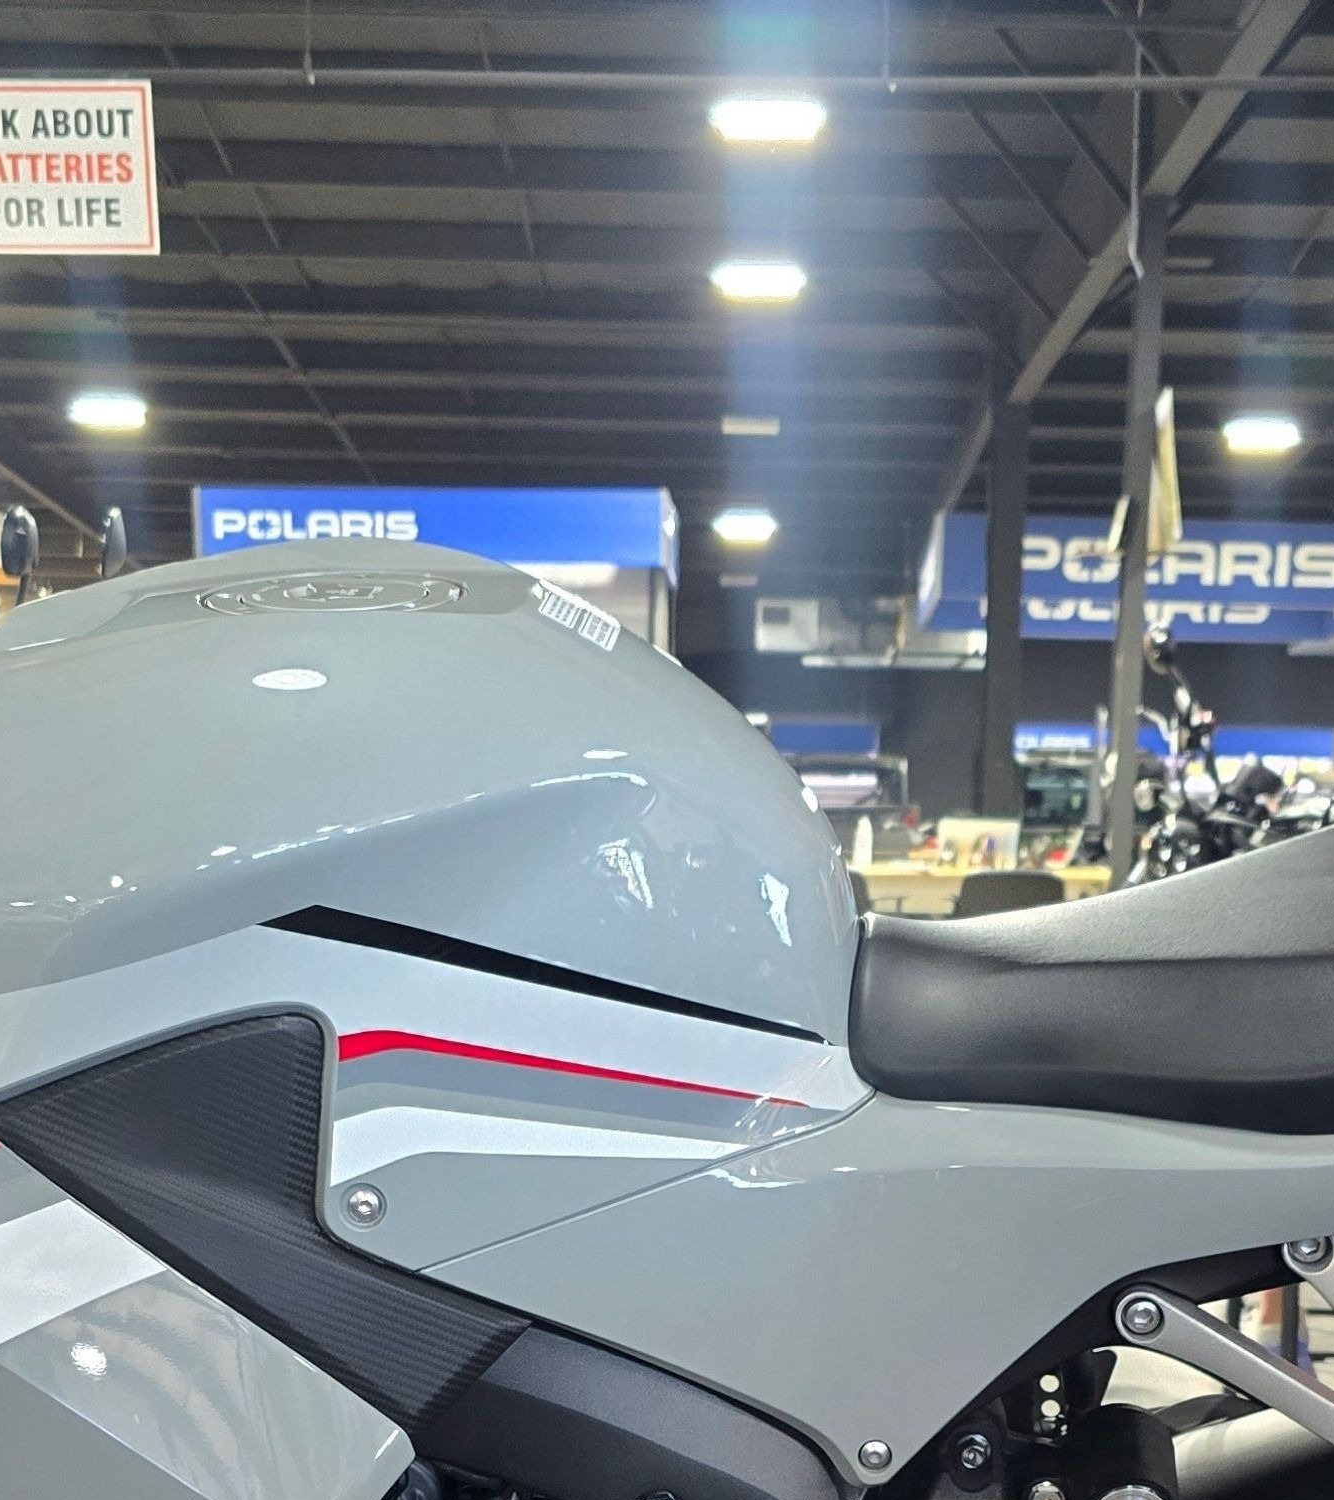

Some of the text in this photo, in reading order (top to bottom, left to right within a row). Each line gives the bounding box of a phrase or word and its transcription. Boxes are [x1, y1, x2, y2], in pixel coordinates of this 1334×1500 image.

[32, 108, 134, 139] ABOUT
[57, 198, 122, 228] LIFE
[213, 509, 419, 541] POLARIS
